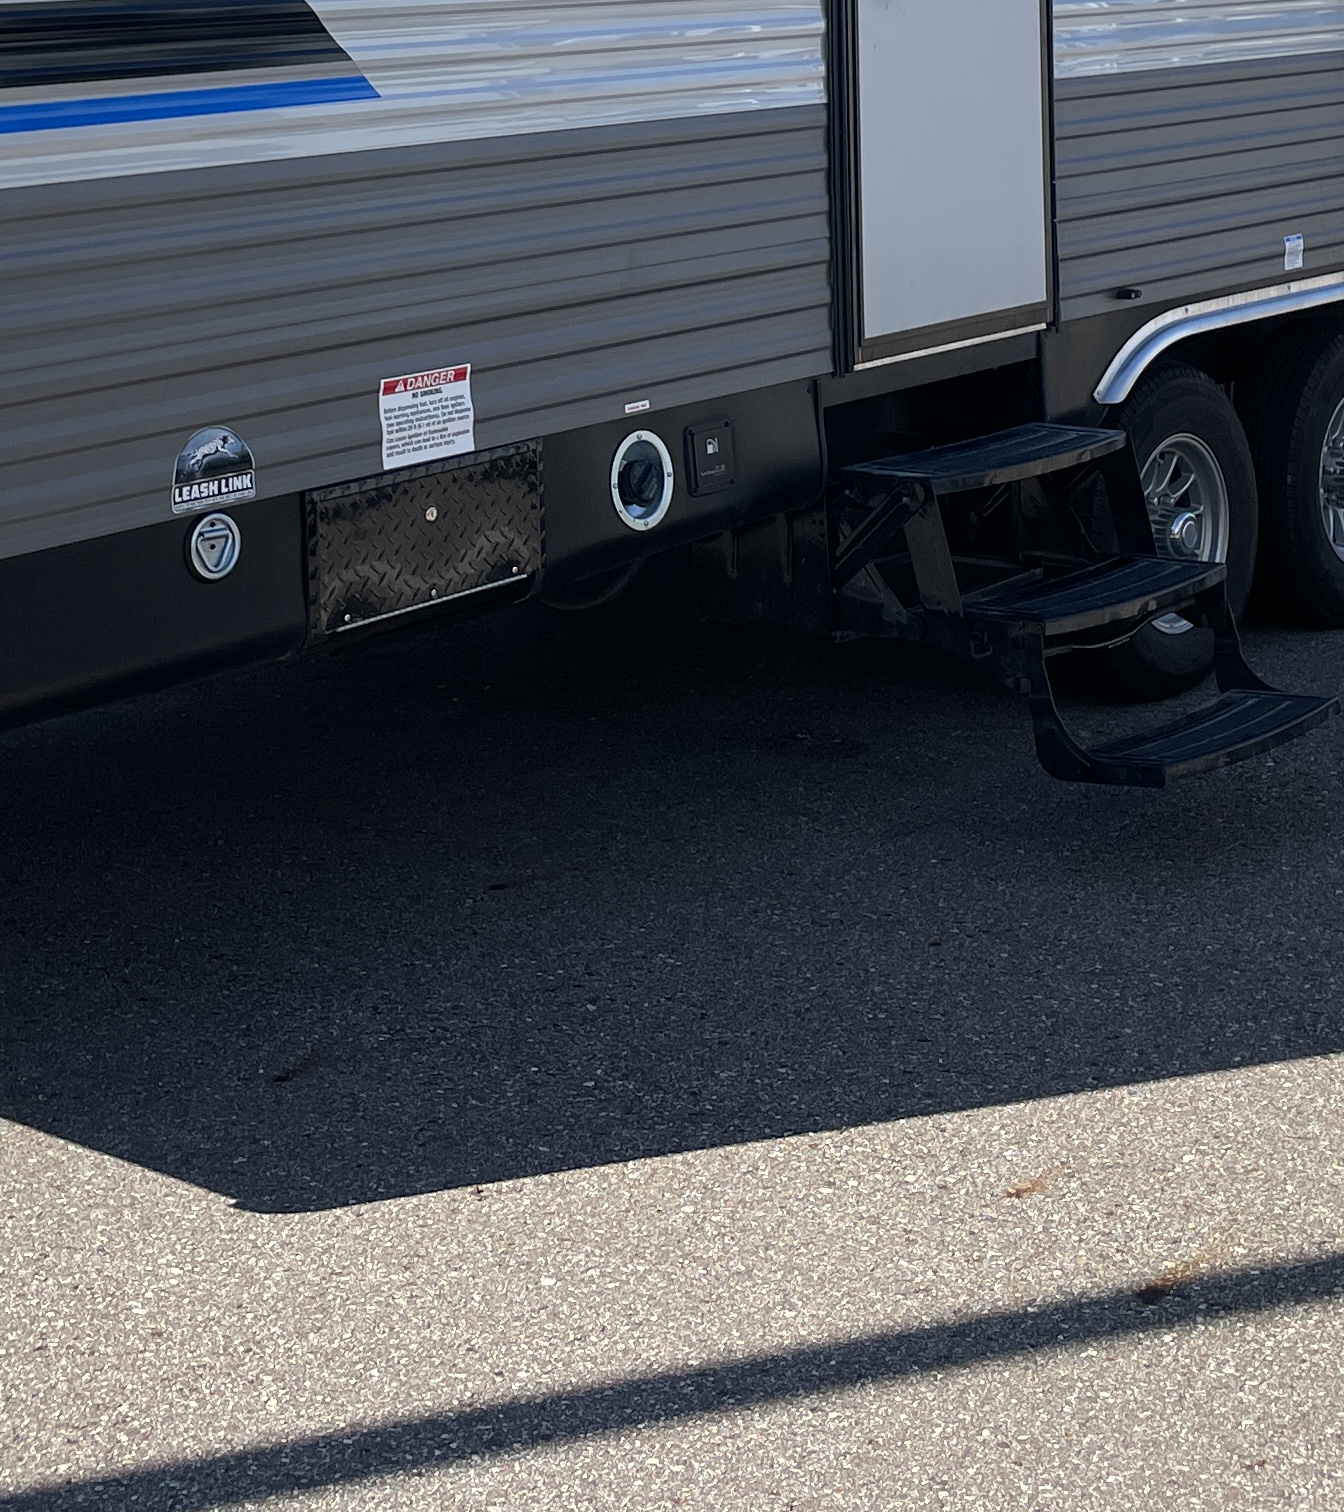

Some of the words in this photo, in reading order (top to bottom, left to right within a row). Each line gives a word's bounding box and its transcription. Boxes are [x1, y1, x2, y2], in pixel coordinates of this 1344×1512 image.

[407, 371, 455, 389] DANGER
[174, 479, 219, 503] LEASH
[221, 473, 253, 494] LINK
